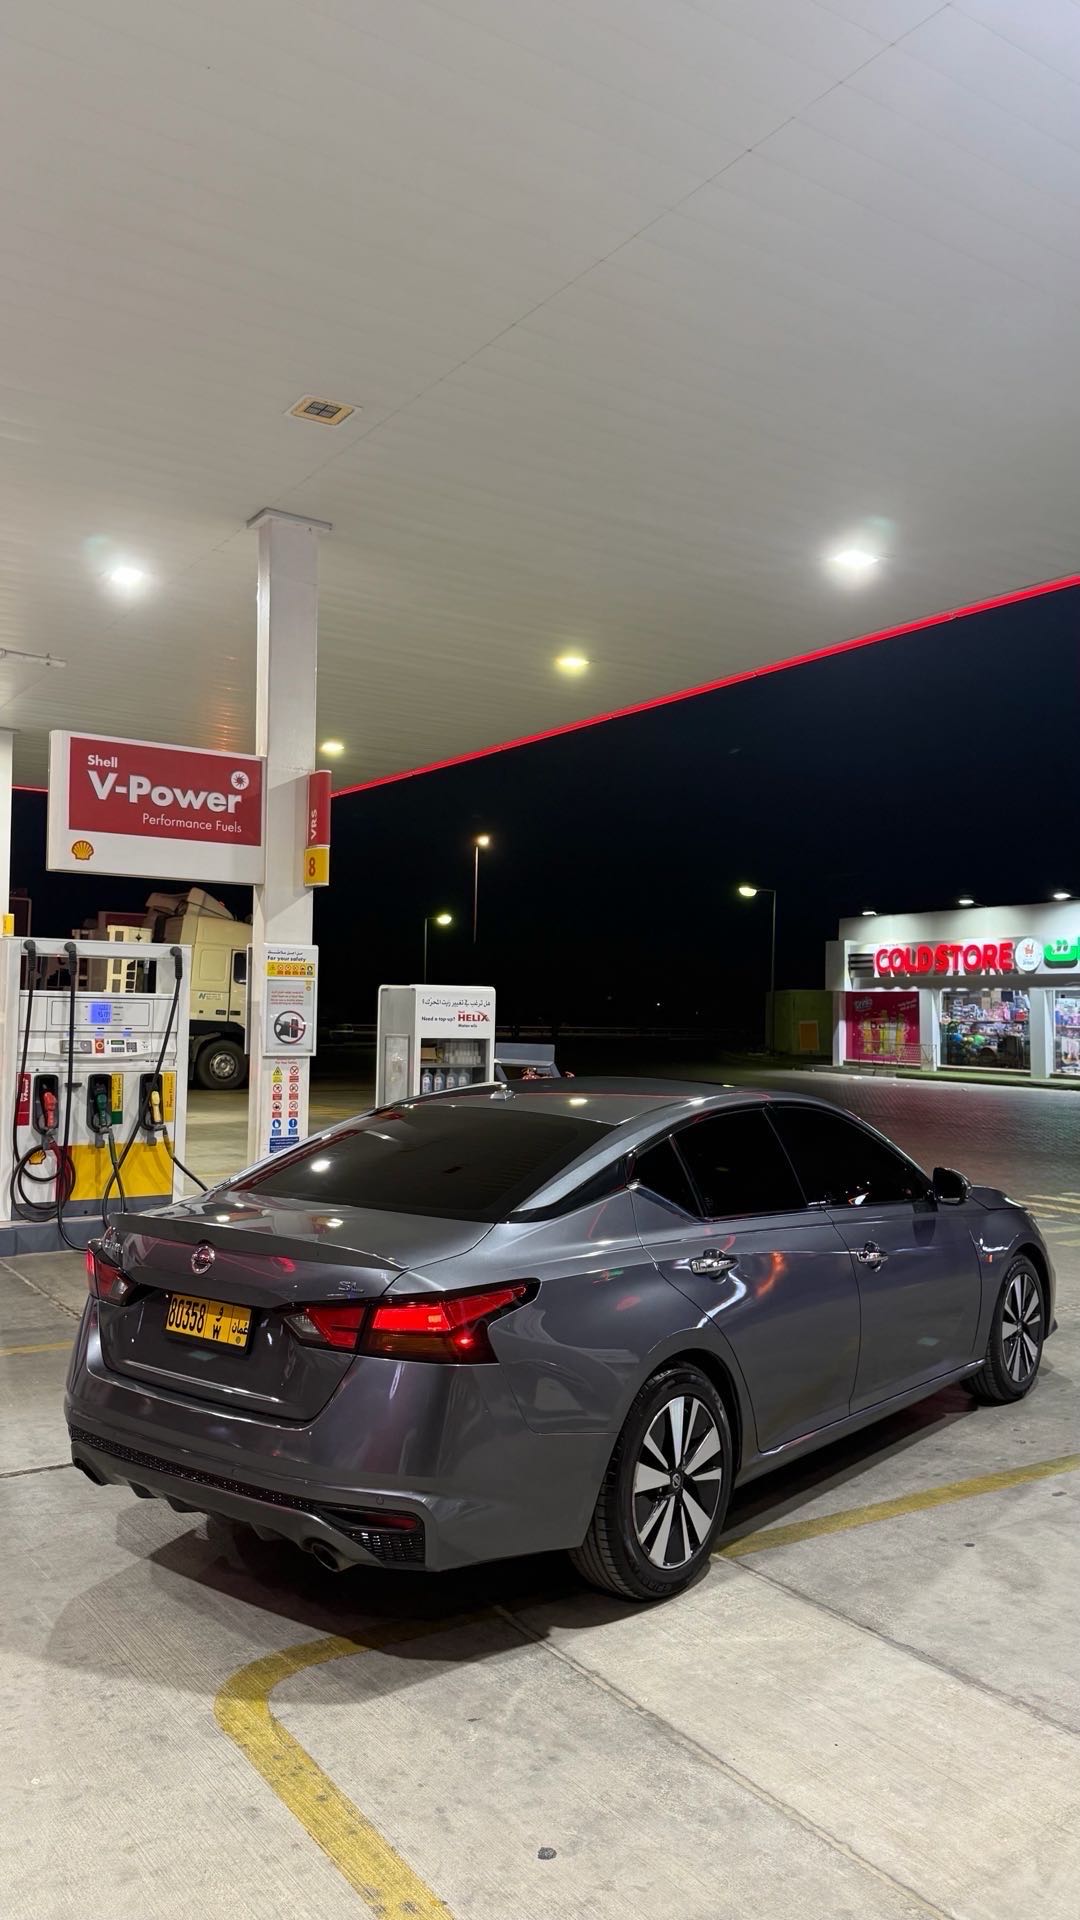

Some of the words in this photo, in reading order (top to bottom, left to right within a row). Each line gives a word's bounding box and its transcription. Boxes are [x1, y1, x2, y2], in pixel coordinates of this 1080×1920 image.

[87, 754, 118, 769] Shell
[87, 769, 242, 814] V-Power
[142, 812, 213, 831] Performance
[215, 819, 242, 833] Fuels
[310, 808, 318, 840] VRS
[308, 856, 316, 877] 8
[876, 945, 934, 972] COLD
[934, 942, 1014, 972] STORE
[457, 1013, 489, 1022] HELIX
[168, 1298, 206, 1334] 80358
[212, 1324, 222, 1340] W
